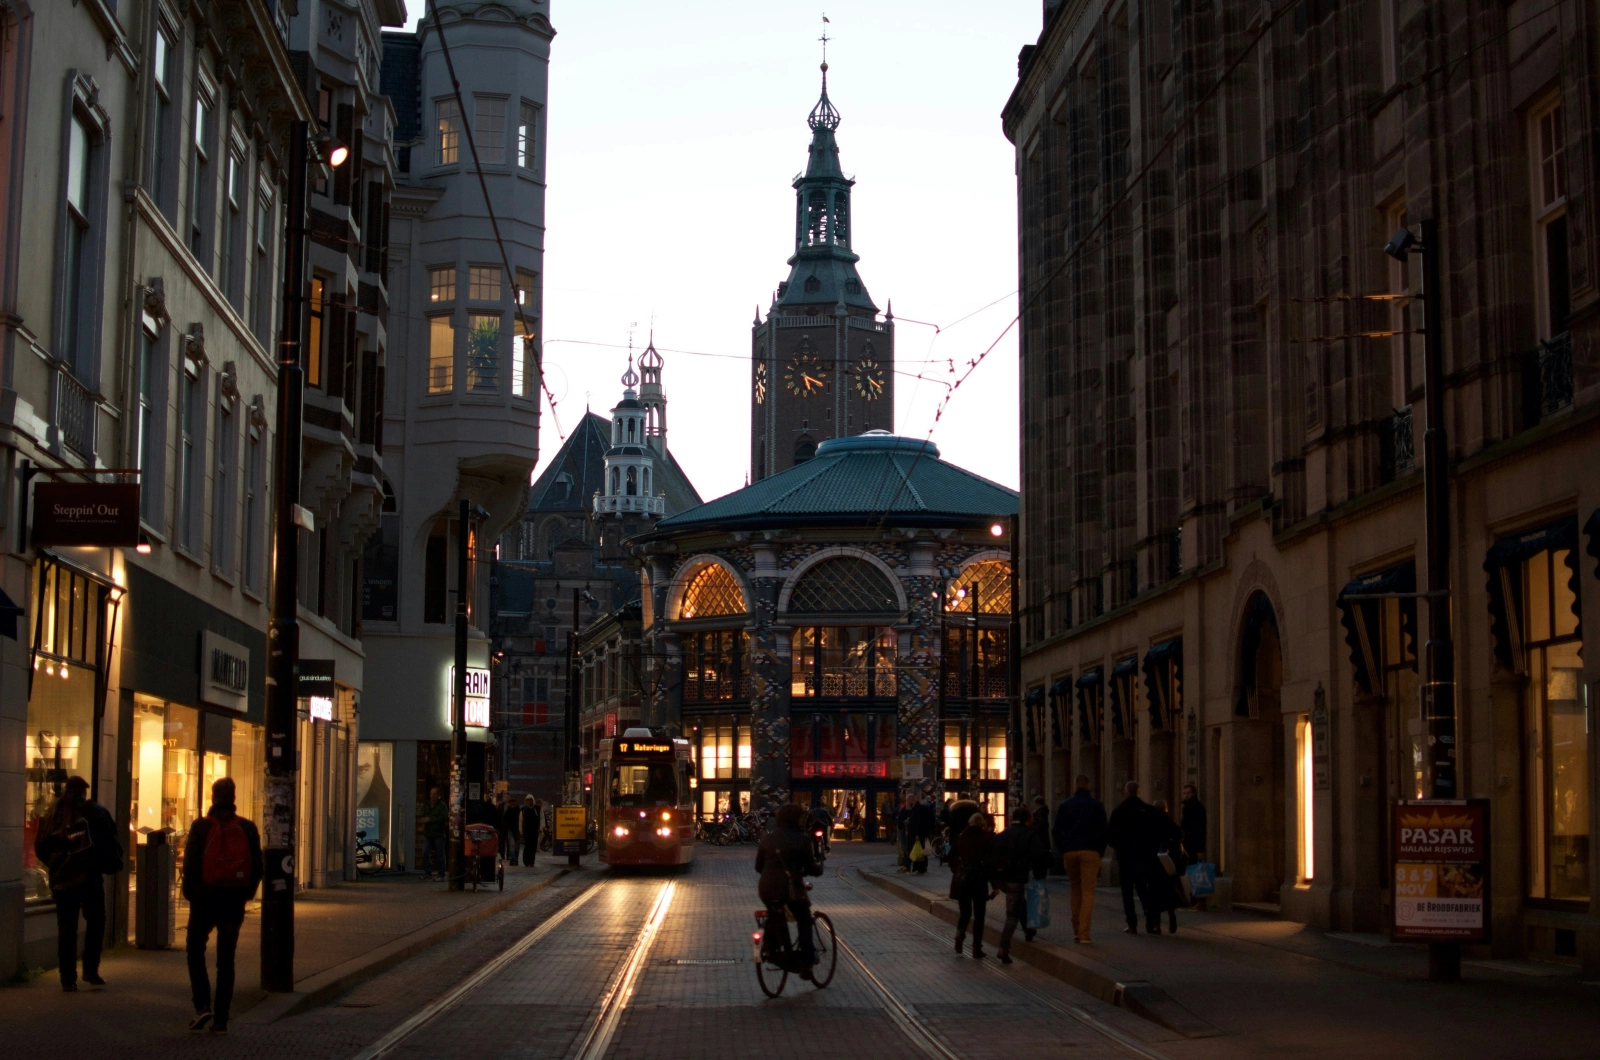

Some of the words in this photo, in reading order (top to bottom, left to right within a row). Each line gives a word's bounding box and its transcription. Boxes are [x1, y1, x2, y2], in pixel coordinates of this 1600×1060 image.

[53, 503, 95, 518] Steppin'
[97, 504, 119, 516] Out
[465, 671, 488, 695] RAIN
[620, 743, 628, 752] 17
[1401, 828, 1475, 844] PASAR
[1396, 868, 1406, 882] 8
[1422, 868, 1434, 882] 9
[1396, 884, 1428, 895] NOV
[1417, 903, 1425, 912] DE
